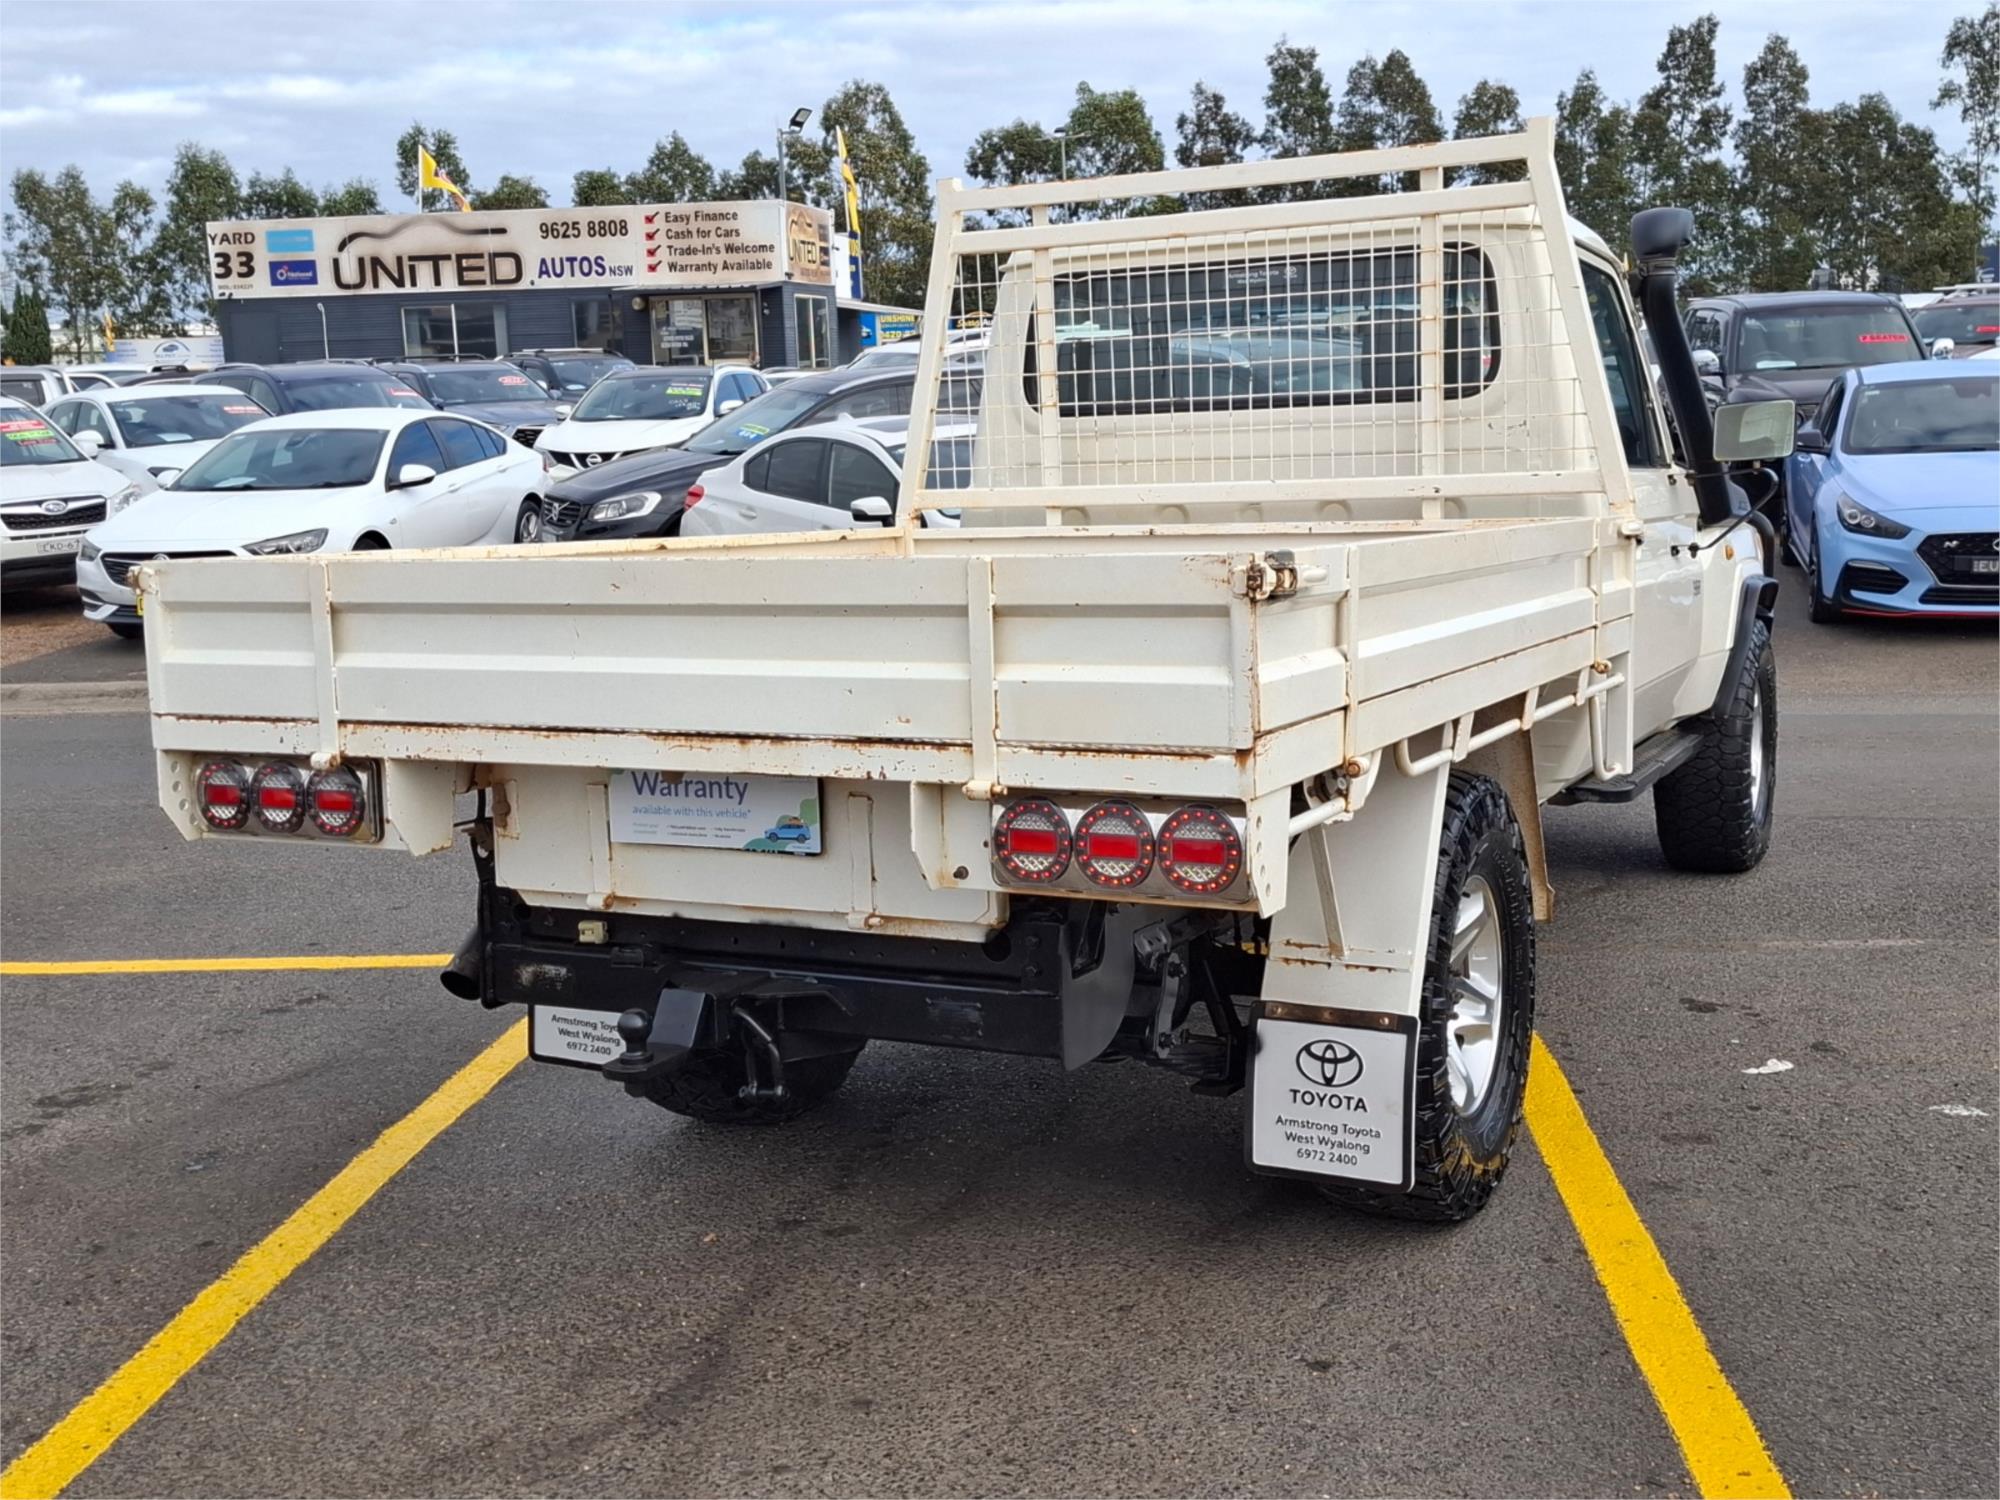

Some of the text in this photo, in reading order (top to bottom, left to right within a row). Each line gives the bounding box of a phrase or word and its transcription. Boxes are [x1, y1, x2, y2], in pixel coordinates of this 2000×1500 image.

[665, 210, 738, 226] Easy Finance
[539, 219, 629, 239] 9625 8808
[666, 226, 740, 240] Cash for Cars
[208, 232, 255, 246] YARD
[667, 243, 775, 257] Trade-In's Welcome
[214, 251, 255, 279] 33
[332, 252, 523, 290] UNITED
[538, 256, 633, 279] AUTOS NSW
[668, 259, 773, 275] Warranty Available
[631, 771, 749, 806] Warranty
[632, 805, 672, 816] available
[674, 807, 694, 817] with
[696, 807, 713, 817] this
[551, 1014, 619, 1033] Armstrong Toyo
[558, 1027, 621, 1047] West Wyalong
[566, 1041, 612, 1056] 6972 2400
[1289, 1088, 1368, 1113] TOYOTA
[1275, 1115, 1381, 1139] Armstrong Toyota
[1285, 1131, 1371, 1155] West Wyalong
[1296, 1147, 1358, 1166] 6972 2400
